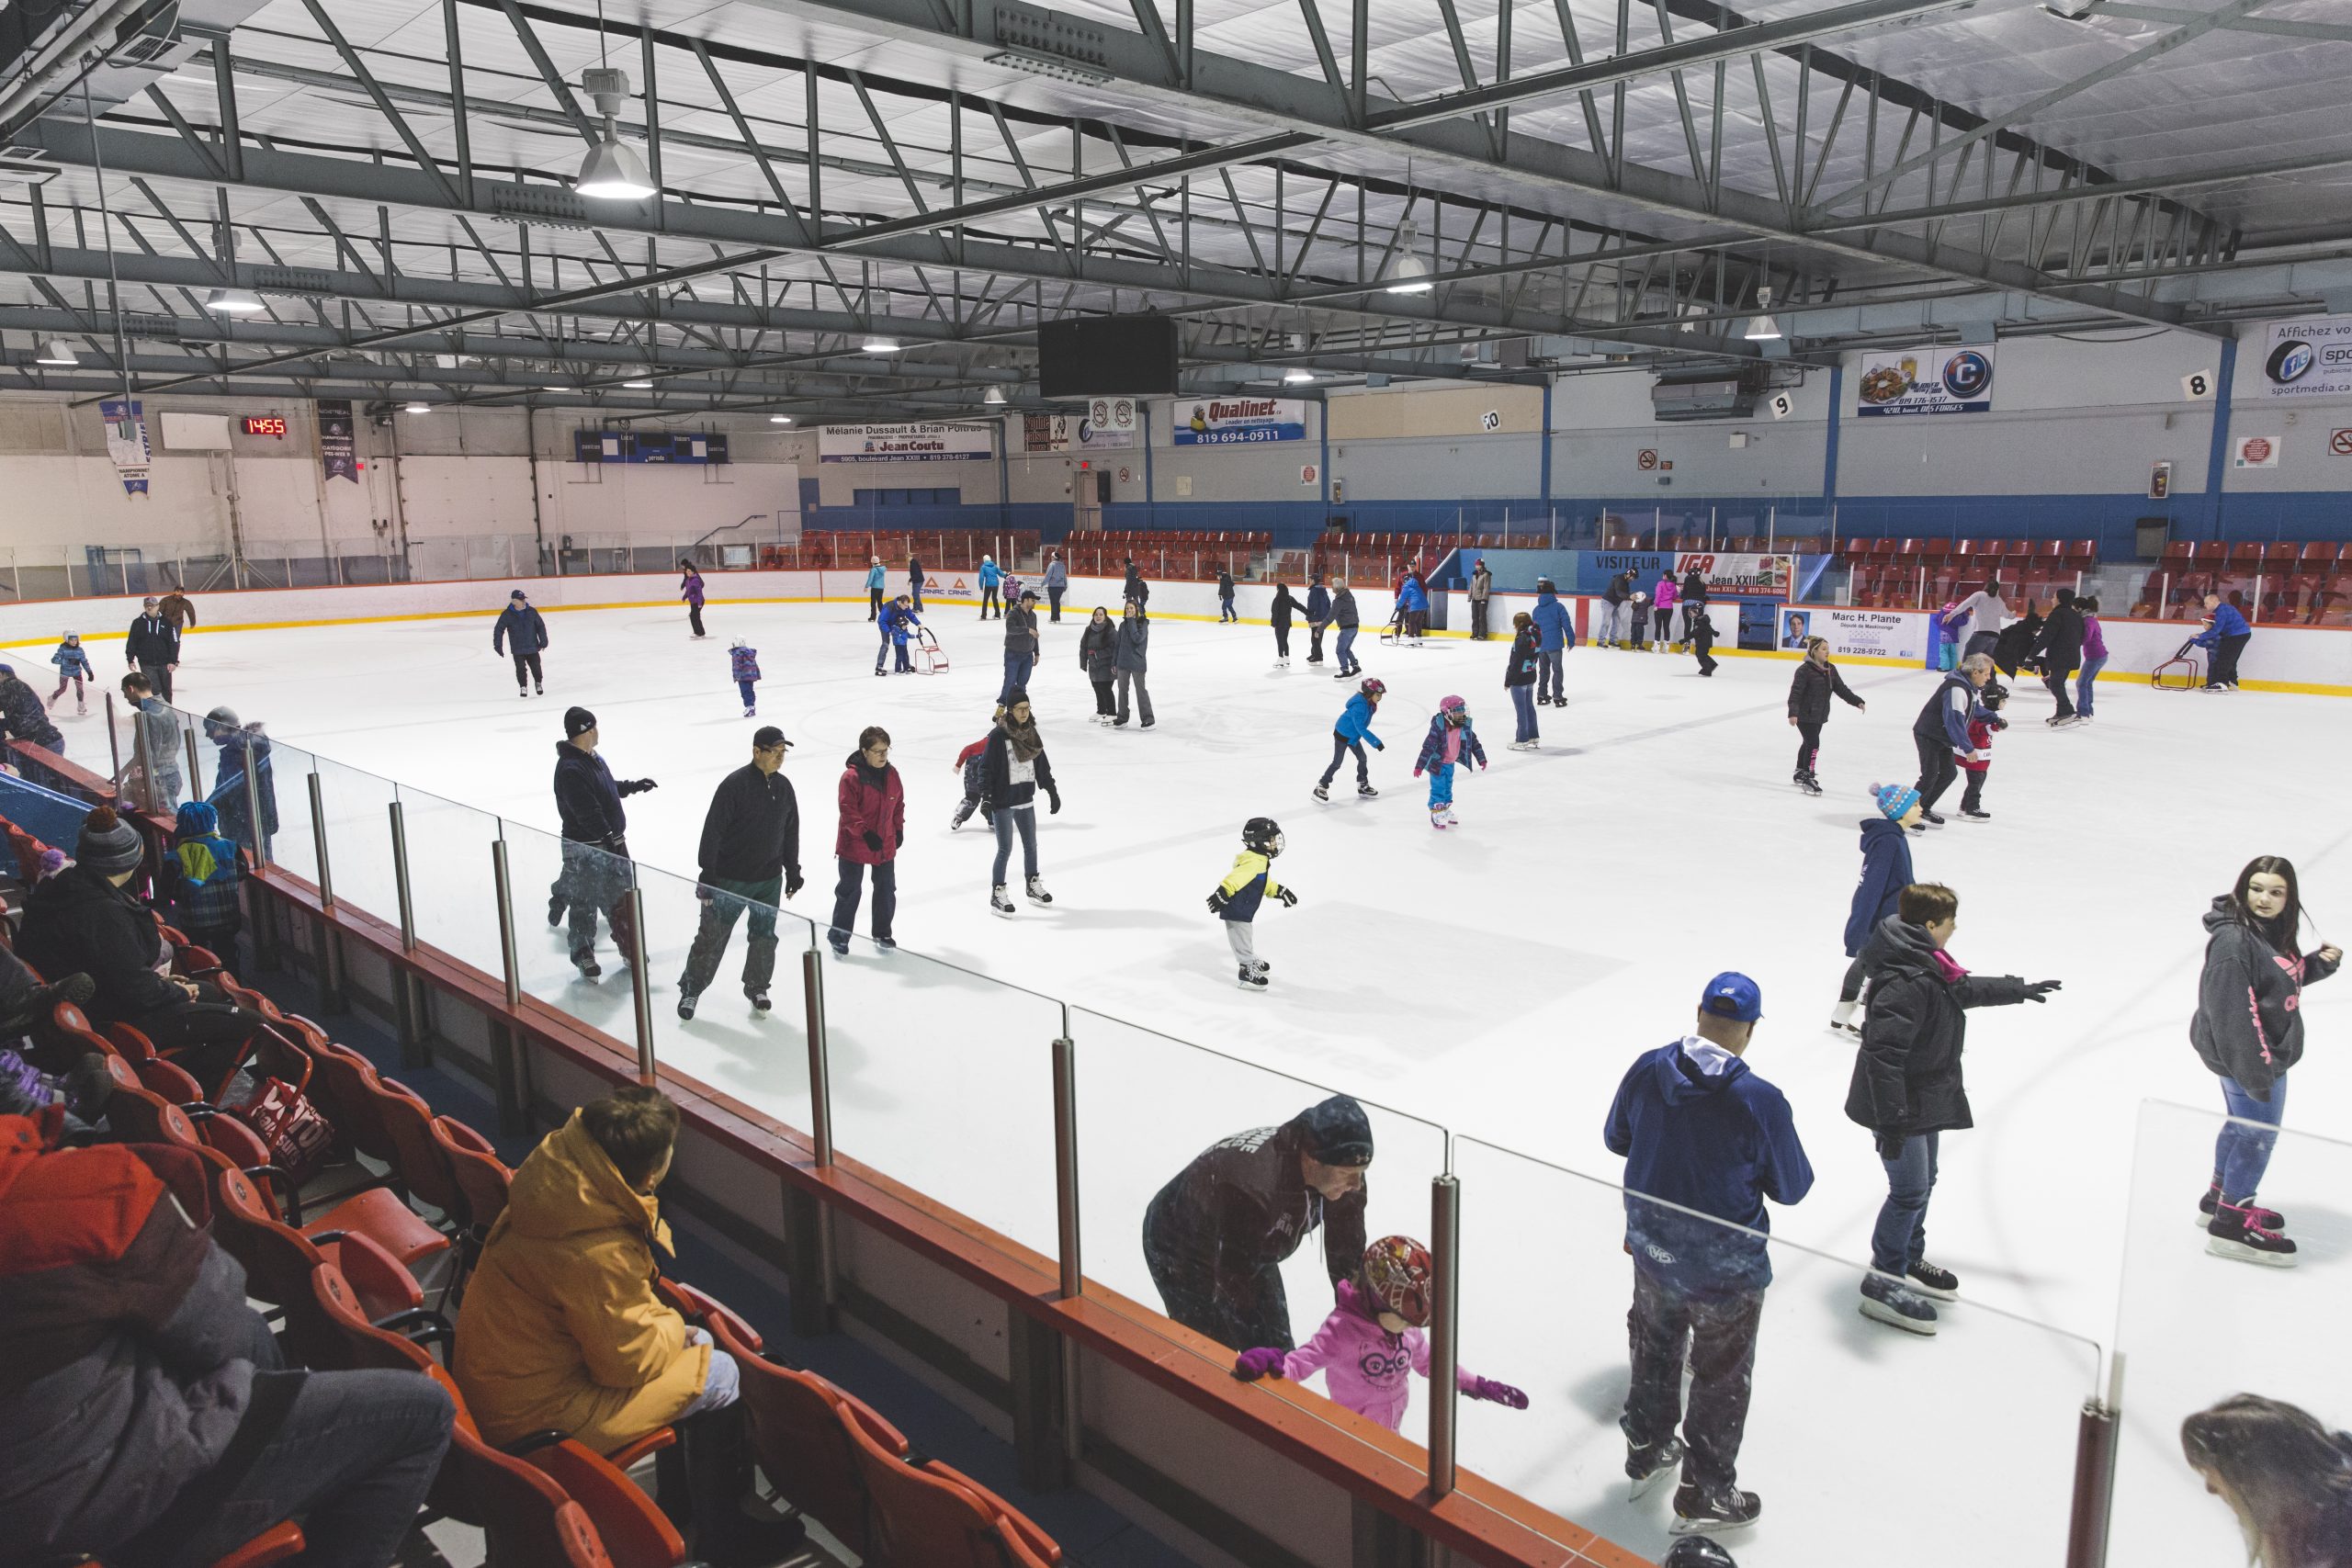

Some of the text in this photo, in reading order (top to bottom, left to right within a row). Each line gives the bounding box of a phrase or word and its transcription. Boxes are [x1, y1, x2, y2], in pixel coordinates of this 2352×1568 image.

[2278, 325, 2352, 338] Affichez vo
[2190, 376, 2206, 395] 8
[2271, 383, 2350, 396] sportmedia.ca
[1777, 397, 1788, 413] 9
[249, 419, 284, 433] 14:55
[1484, 412, 1498, 430] 10
[826, 425, 863, 434] Mélanie
[865, 425, 908, 434] Dussault
[910, 425, 917, 434] &
[920, 424, 944, 434] Brian
[1197, 431, 1279, 444] 819 694-0911
[1596, 555, 1660, 570] VISITEUR
[1676, 554, 1715, 574] IGA
[1709, 574, 1733, 586] Jean
[1832, 612, 1901, 624] Marc H. Plante
[1853, 648, 1886, 656] 228-9722
